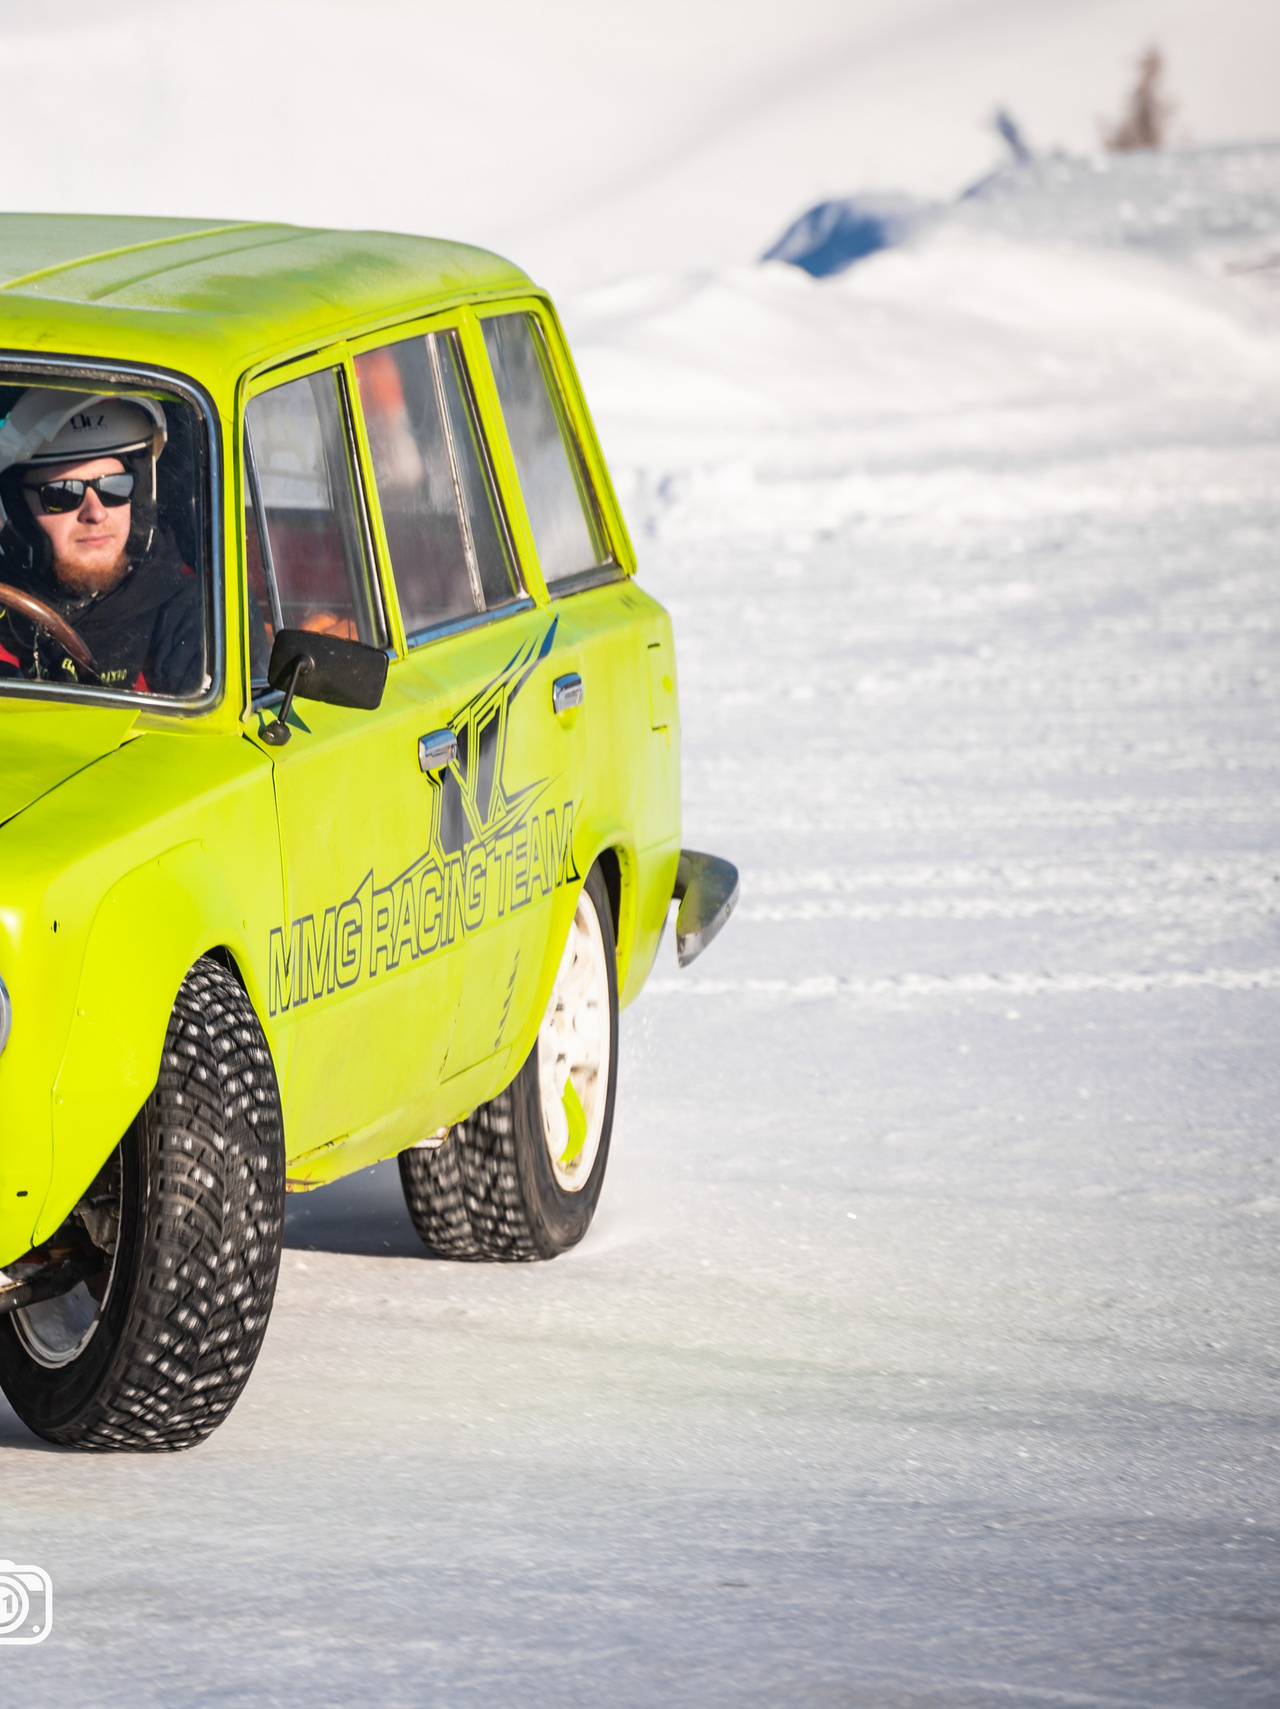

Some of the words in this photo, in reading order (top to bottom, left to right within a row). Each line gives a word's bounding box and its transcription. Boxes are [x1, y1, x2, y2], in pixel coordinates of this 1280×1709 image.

[269, 897, 363, 1018] MMG
[369, 844, 488, 978] RACING
[494, 800, 581, 918] TEAM
